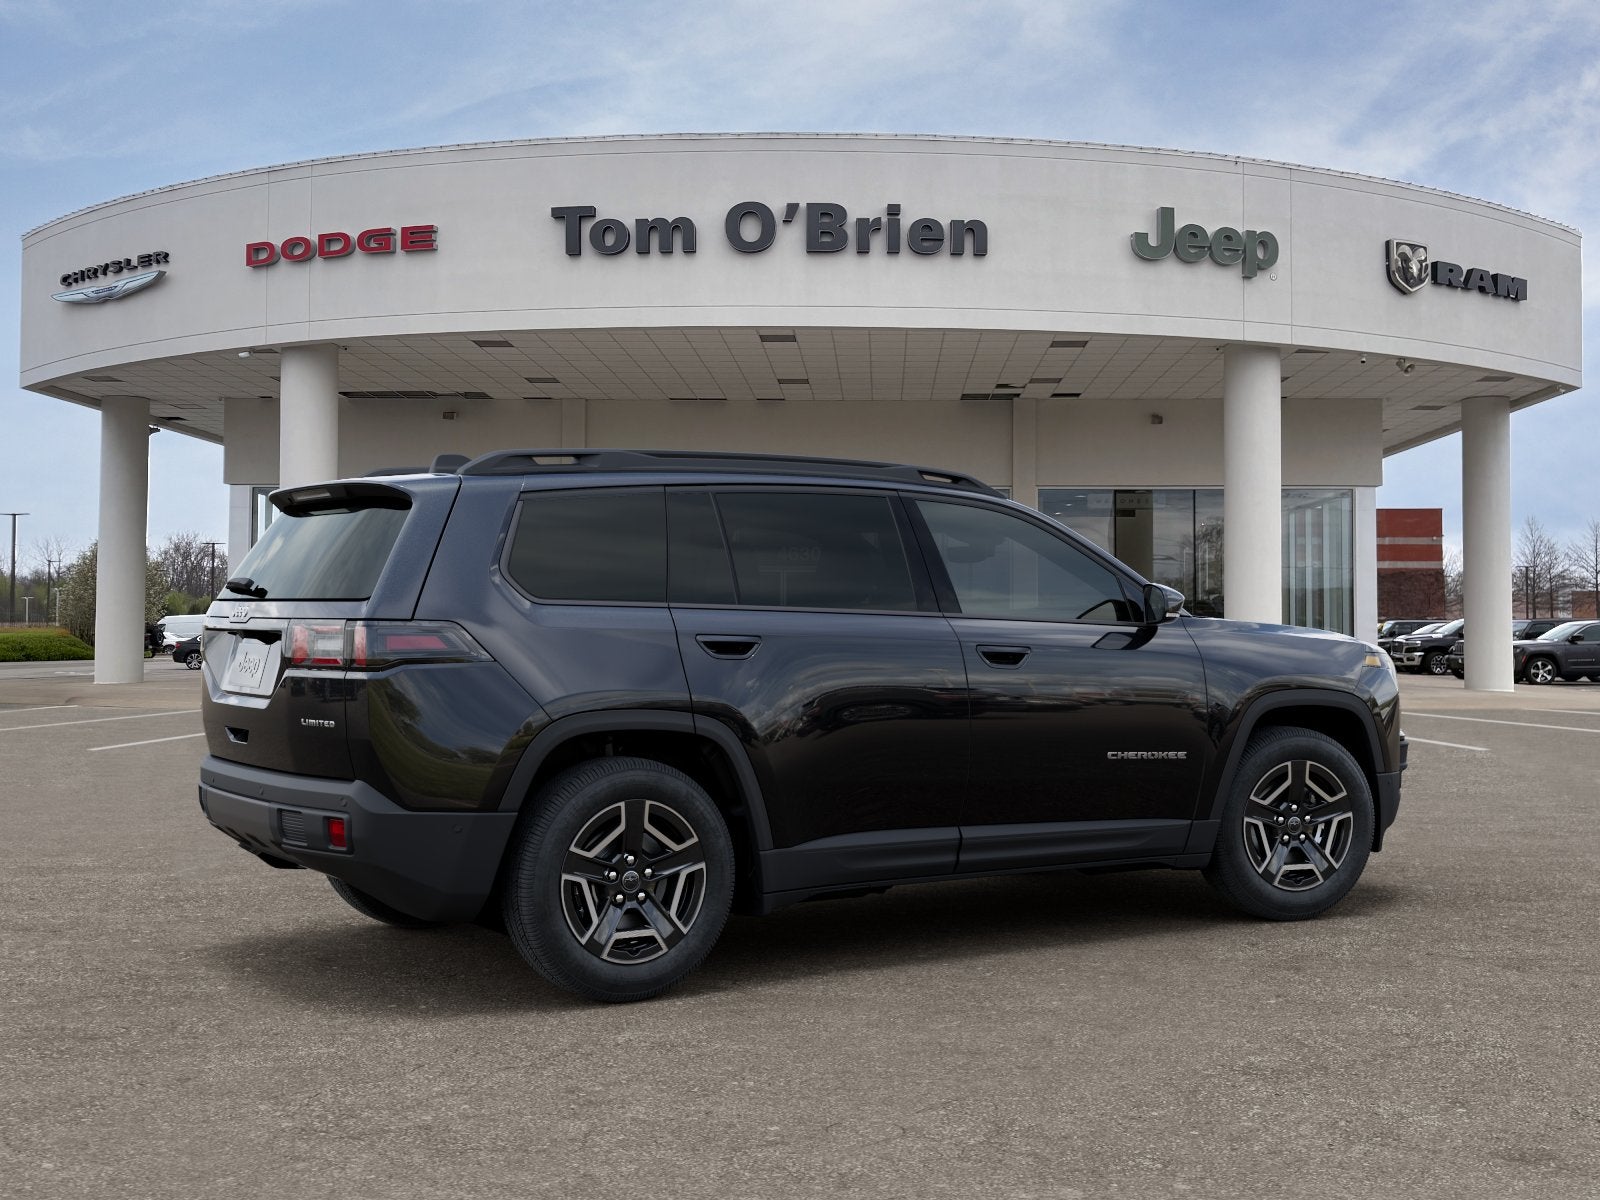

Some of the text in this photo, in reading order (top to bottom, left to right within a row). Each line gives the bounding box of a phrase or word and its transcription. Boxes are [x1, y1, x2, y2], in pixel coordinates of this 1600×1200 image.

[245, 224, 438, 268] DODGE
[551, 201, 989, 256] Tom O'Brien
[1130, 206, 1279, 278] Jeep
[60, 250, 170, 287] CHRYSLER
[1431, 260, 1528, 301] RAM
[300, 718, 335, 727] LIMITED
[1106, 751, 1187, 760] CHEROKEE
